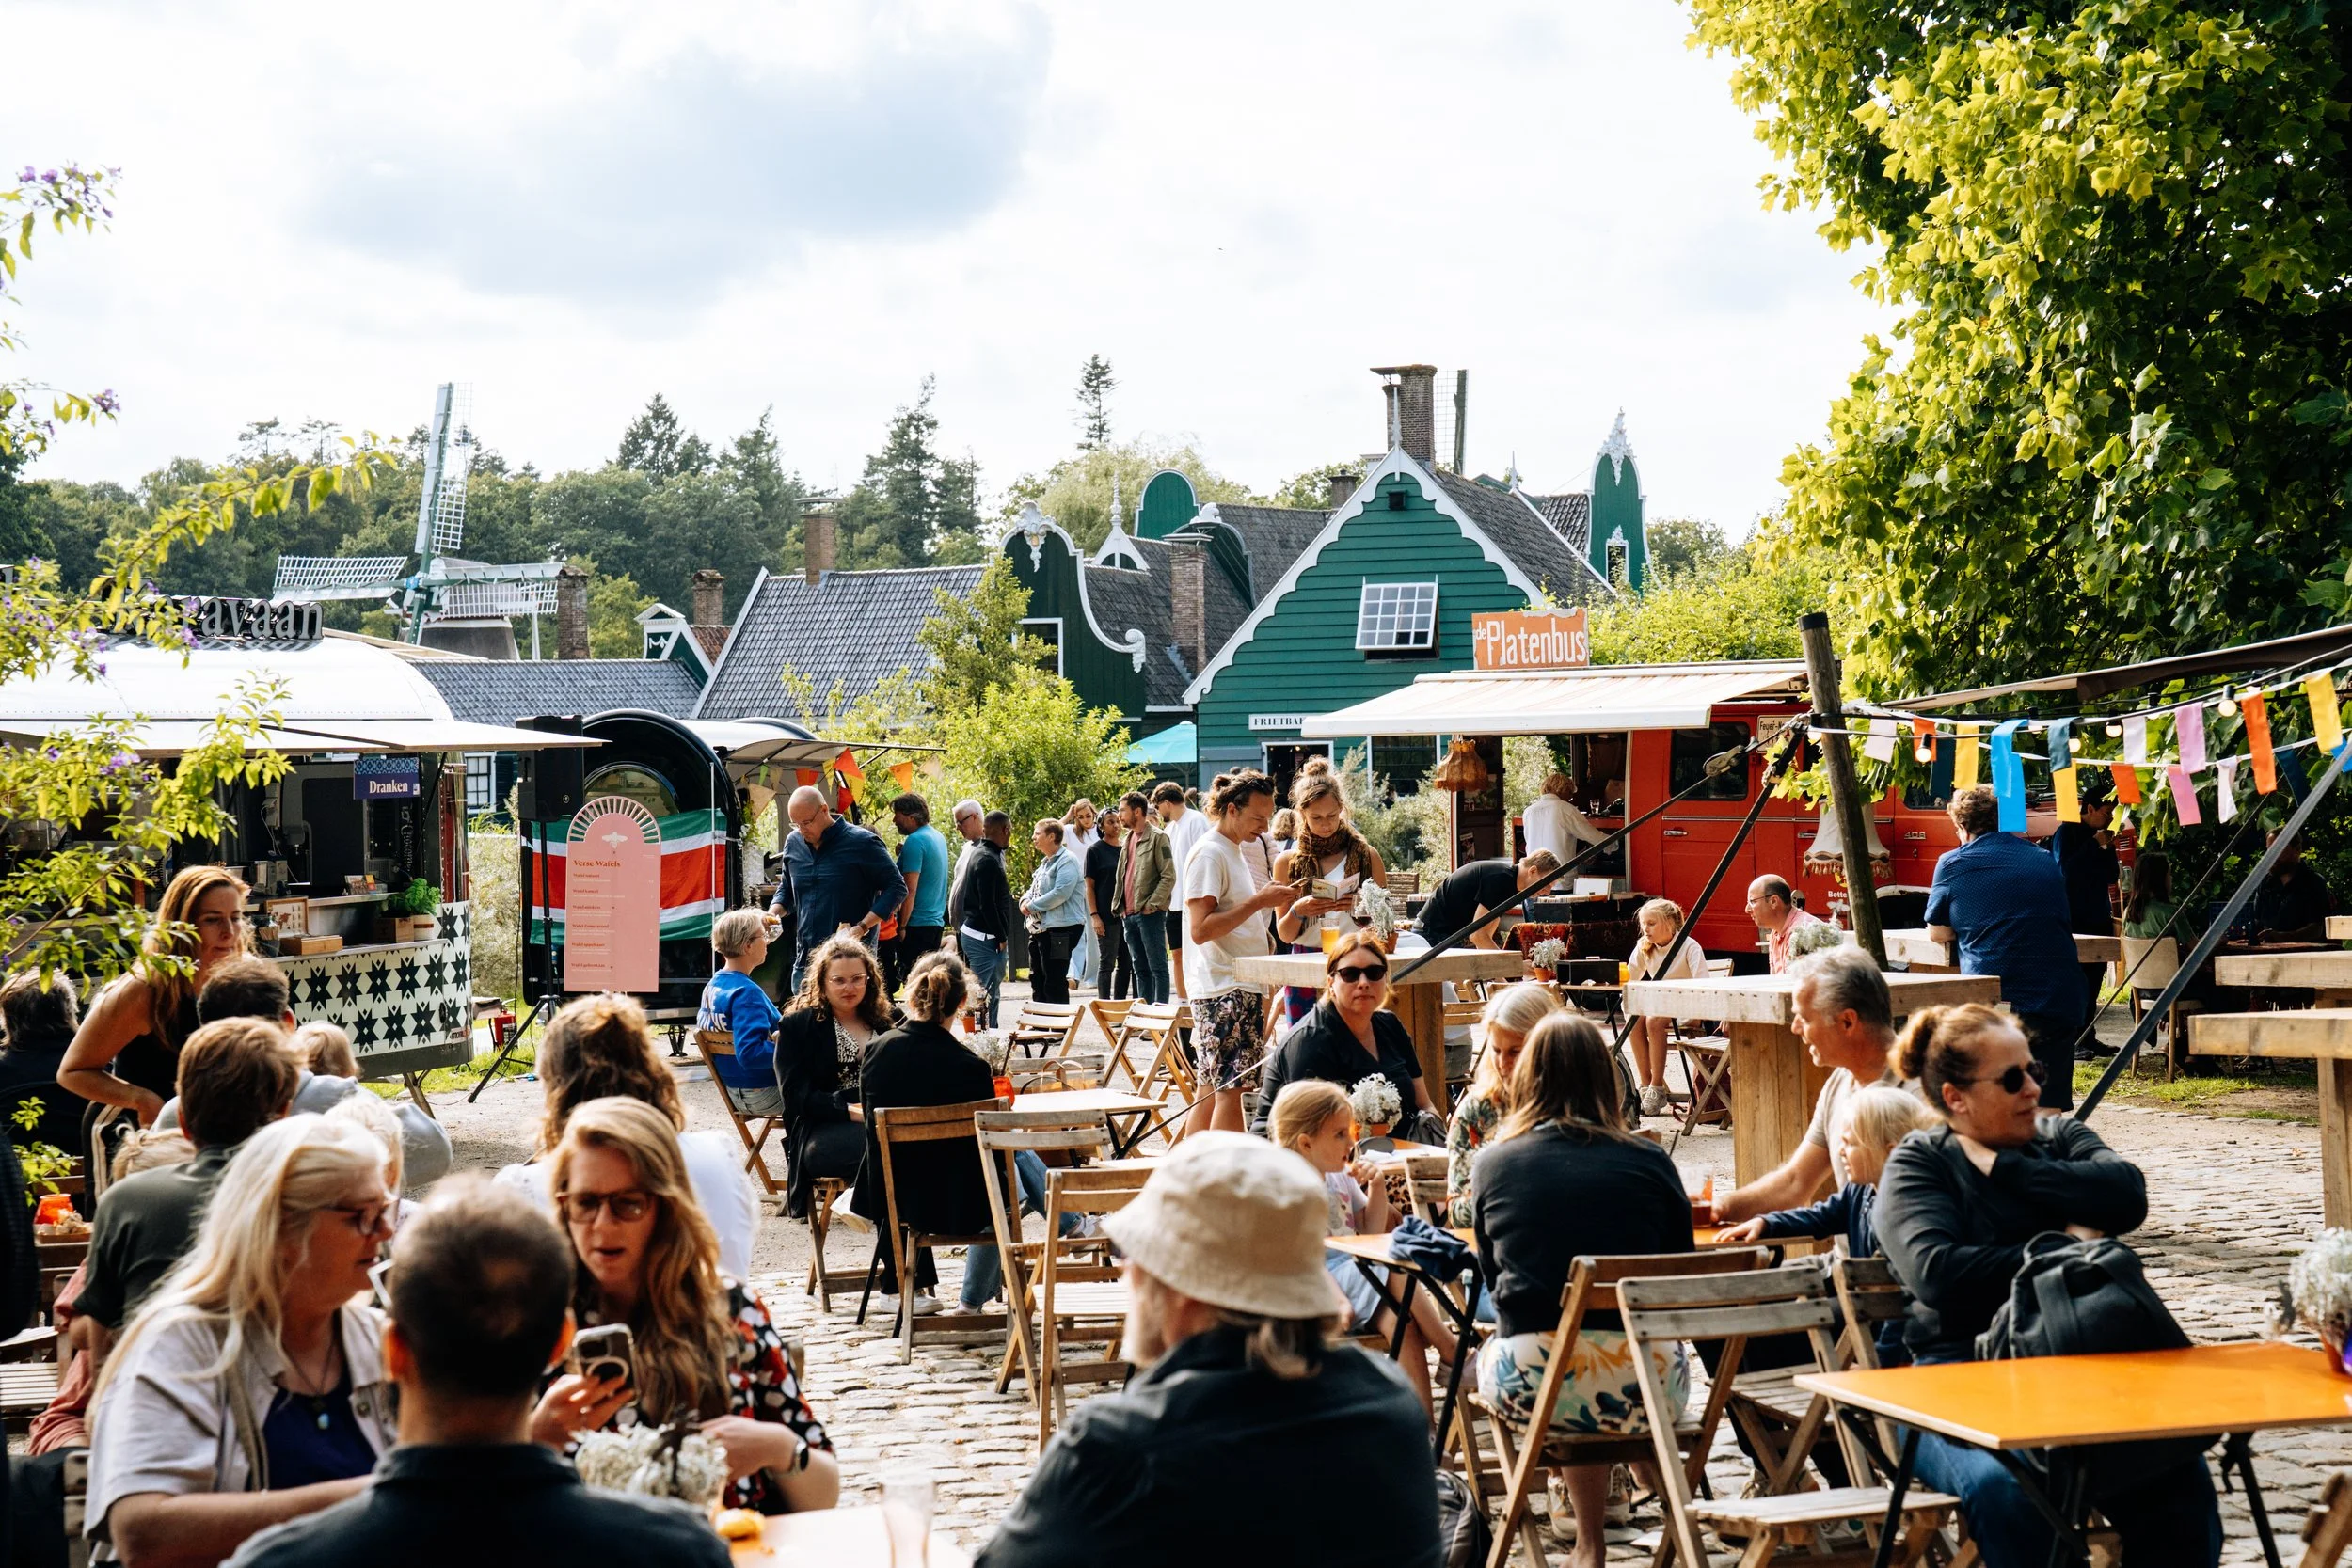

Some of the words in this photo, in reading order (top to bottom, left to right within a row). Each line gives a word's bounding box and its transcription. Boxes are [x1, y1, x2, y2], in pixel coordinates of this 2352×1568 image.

[1476, 621, 1486, 640] de
[1486, 617, 1587, 666] Platenbus
[369, 780, 408, 793] Dranken
